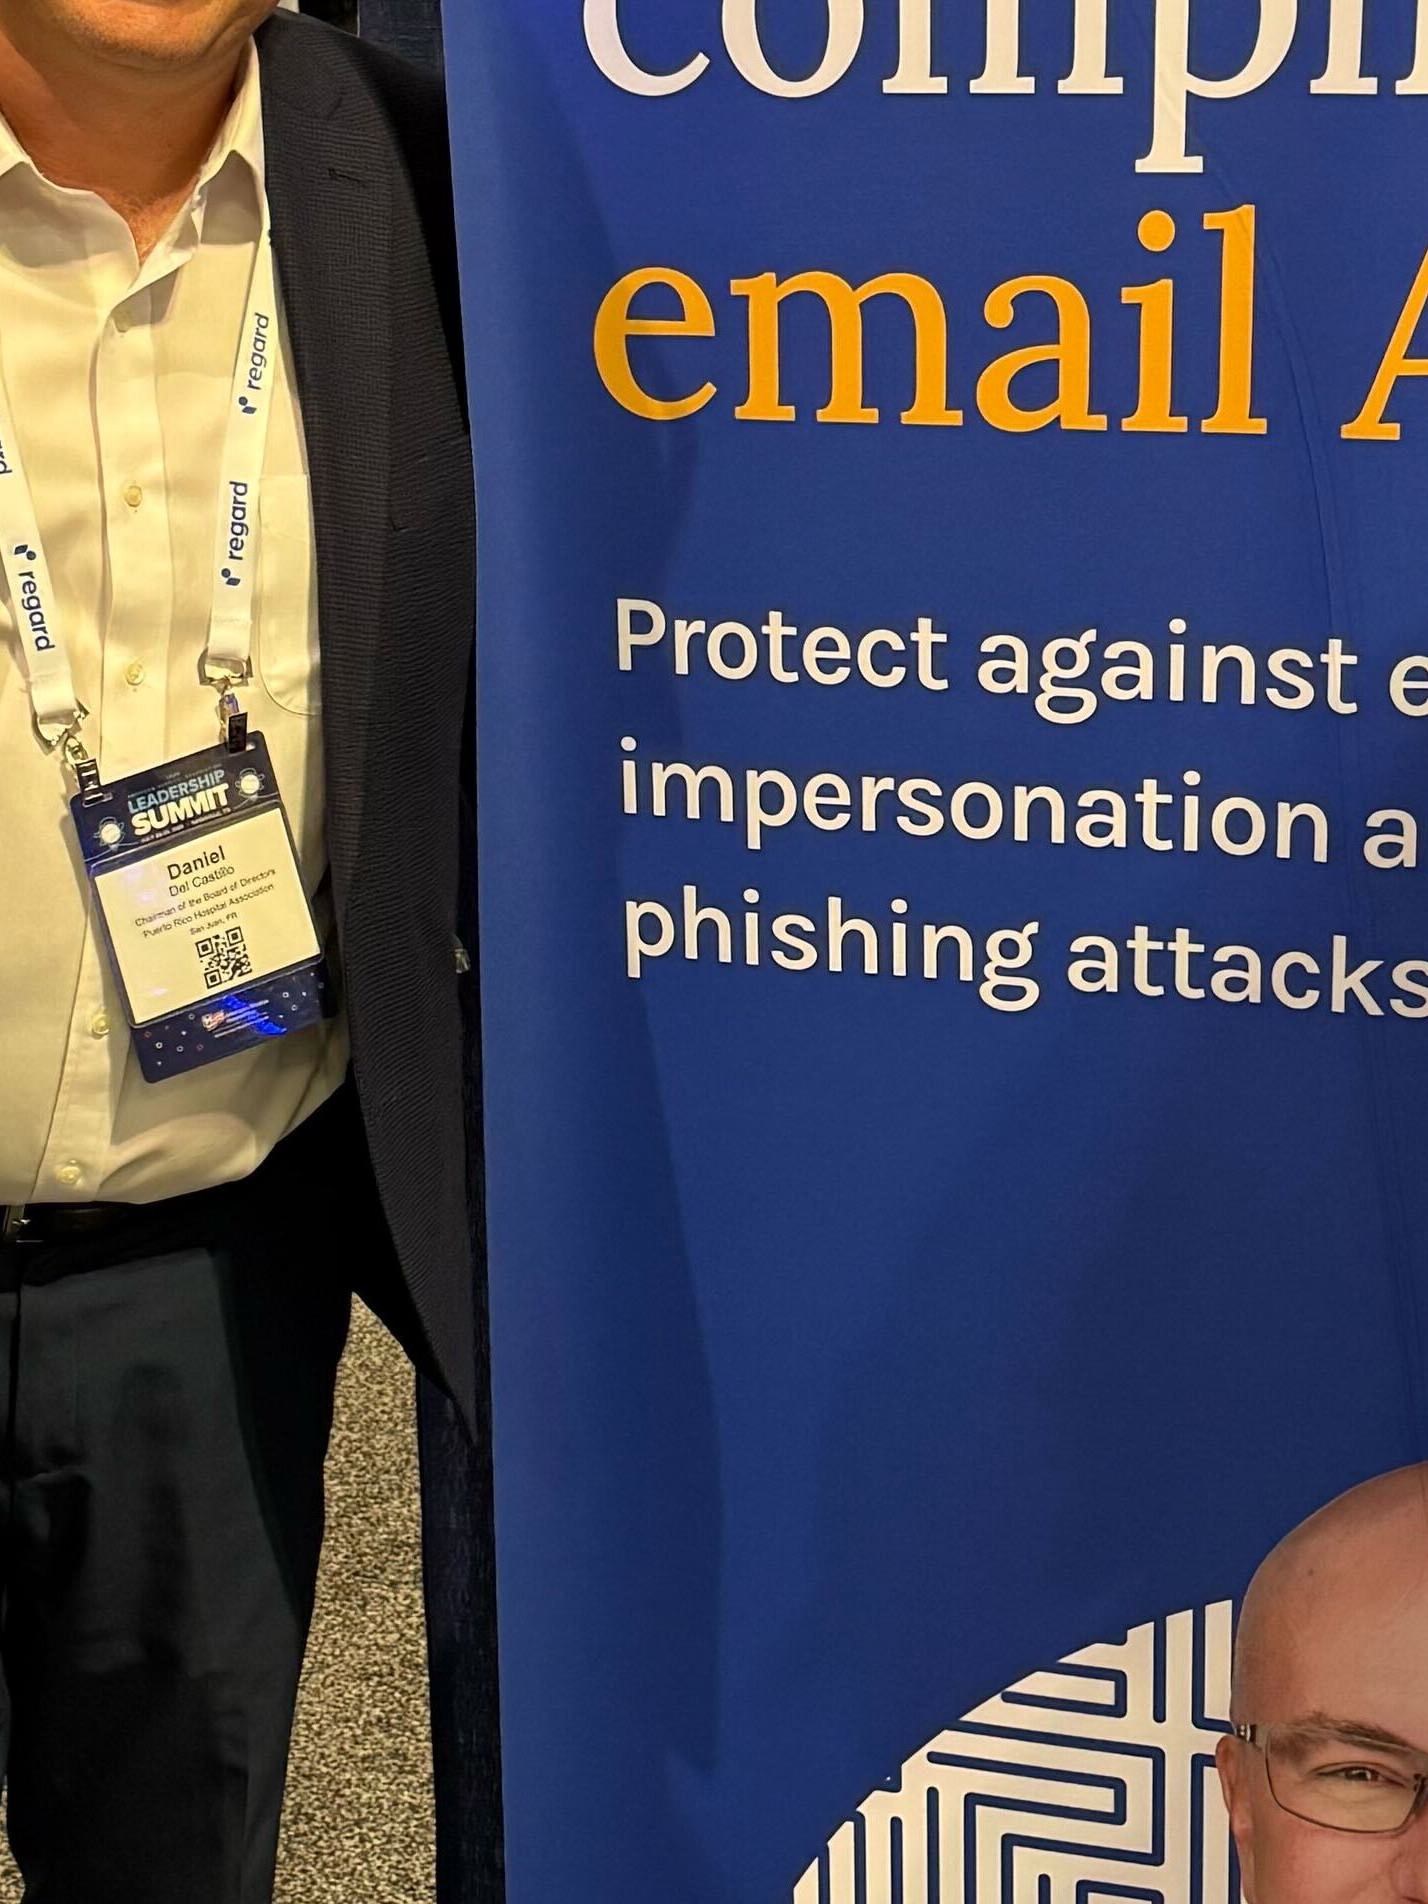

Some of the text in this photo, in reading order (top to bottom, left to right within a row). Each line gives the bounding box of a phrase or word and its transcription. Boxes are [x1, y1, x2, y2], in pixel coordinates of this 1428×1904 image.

[248, 312, 269, 390] regard
[593, 203, 1268, 436] email
[228, 481, 248, 561] regard
[18, 571, 55, 651] regard
[616, 598, 949, 691] Protect
[977, 618, 1358, 725] against
[128, 769, 224, 814] LEADERSHIP
[132, 783, 229, 836] SUMMIT
[620, 736, 1329, 864] impersonation
[168, 845, 226, 880] Daniel
[169, 881, 190, 897] Del
[625, 884, 1040, 1012] phishing
